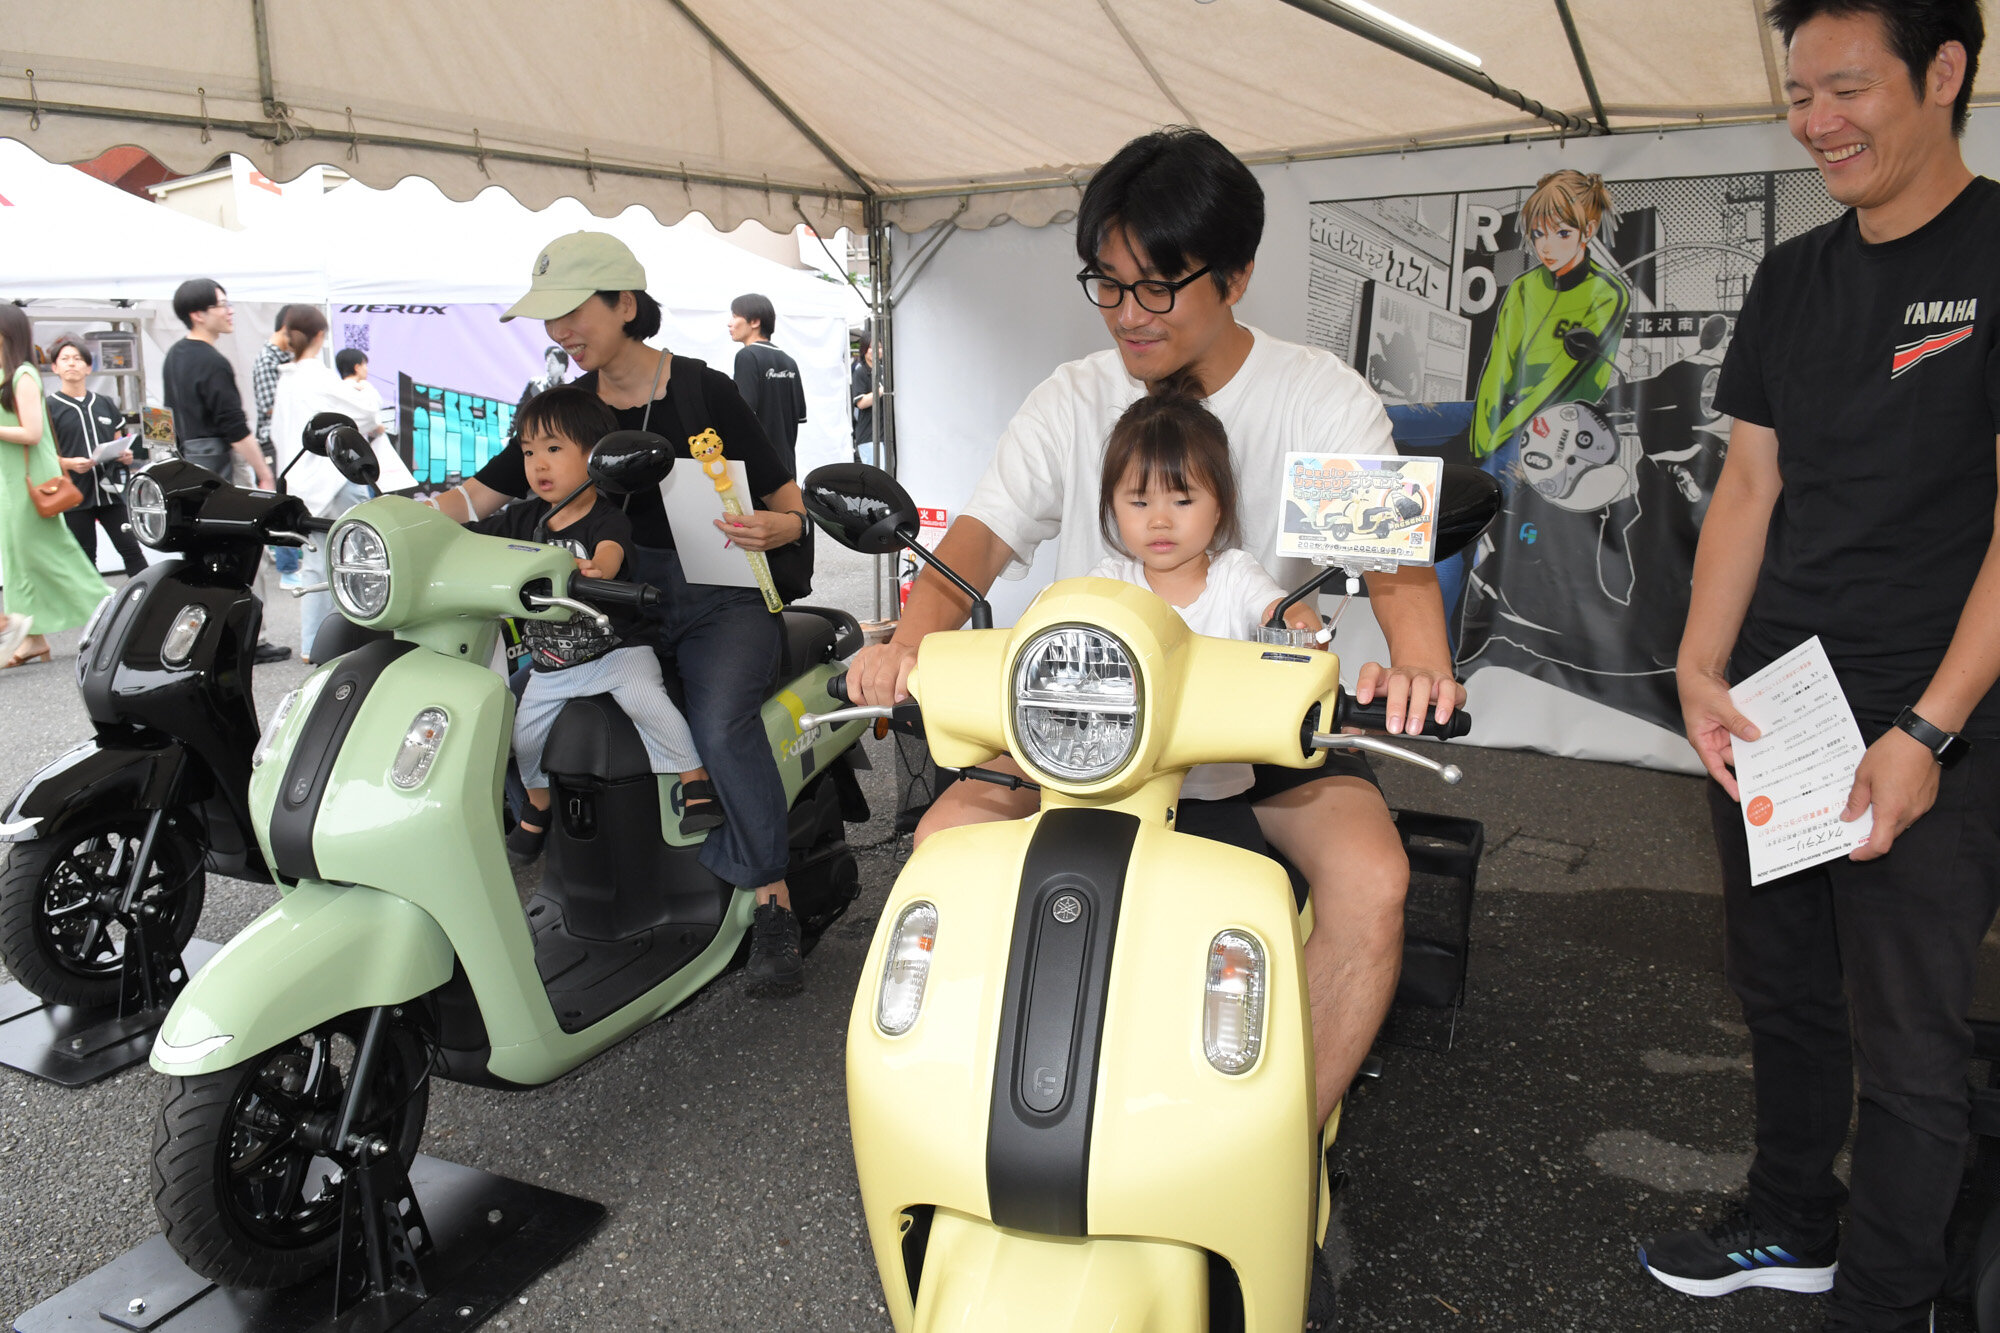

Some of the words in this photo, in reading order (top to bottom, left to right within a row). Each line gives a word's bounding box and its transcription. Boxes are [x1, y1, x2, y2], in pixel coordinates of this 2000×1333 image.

[339, 304, 449, 316] AEROX
[1904, 298, 1978, 325] YAMAHA
[1556, 429, 1570, 453] YAMAHA
[1294, 488, 1352, 501] キャンペーン
[1787, 827, 1844, 851] クイズラリー
